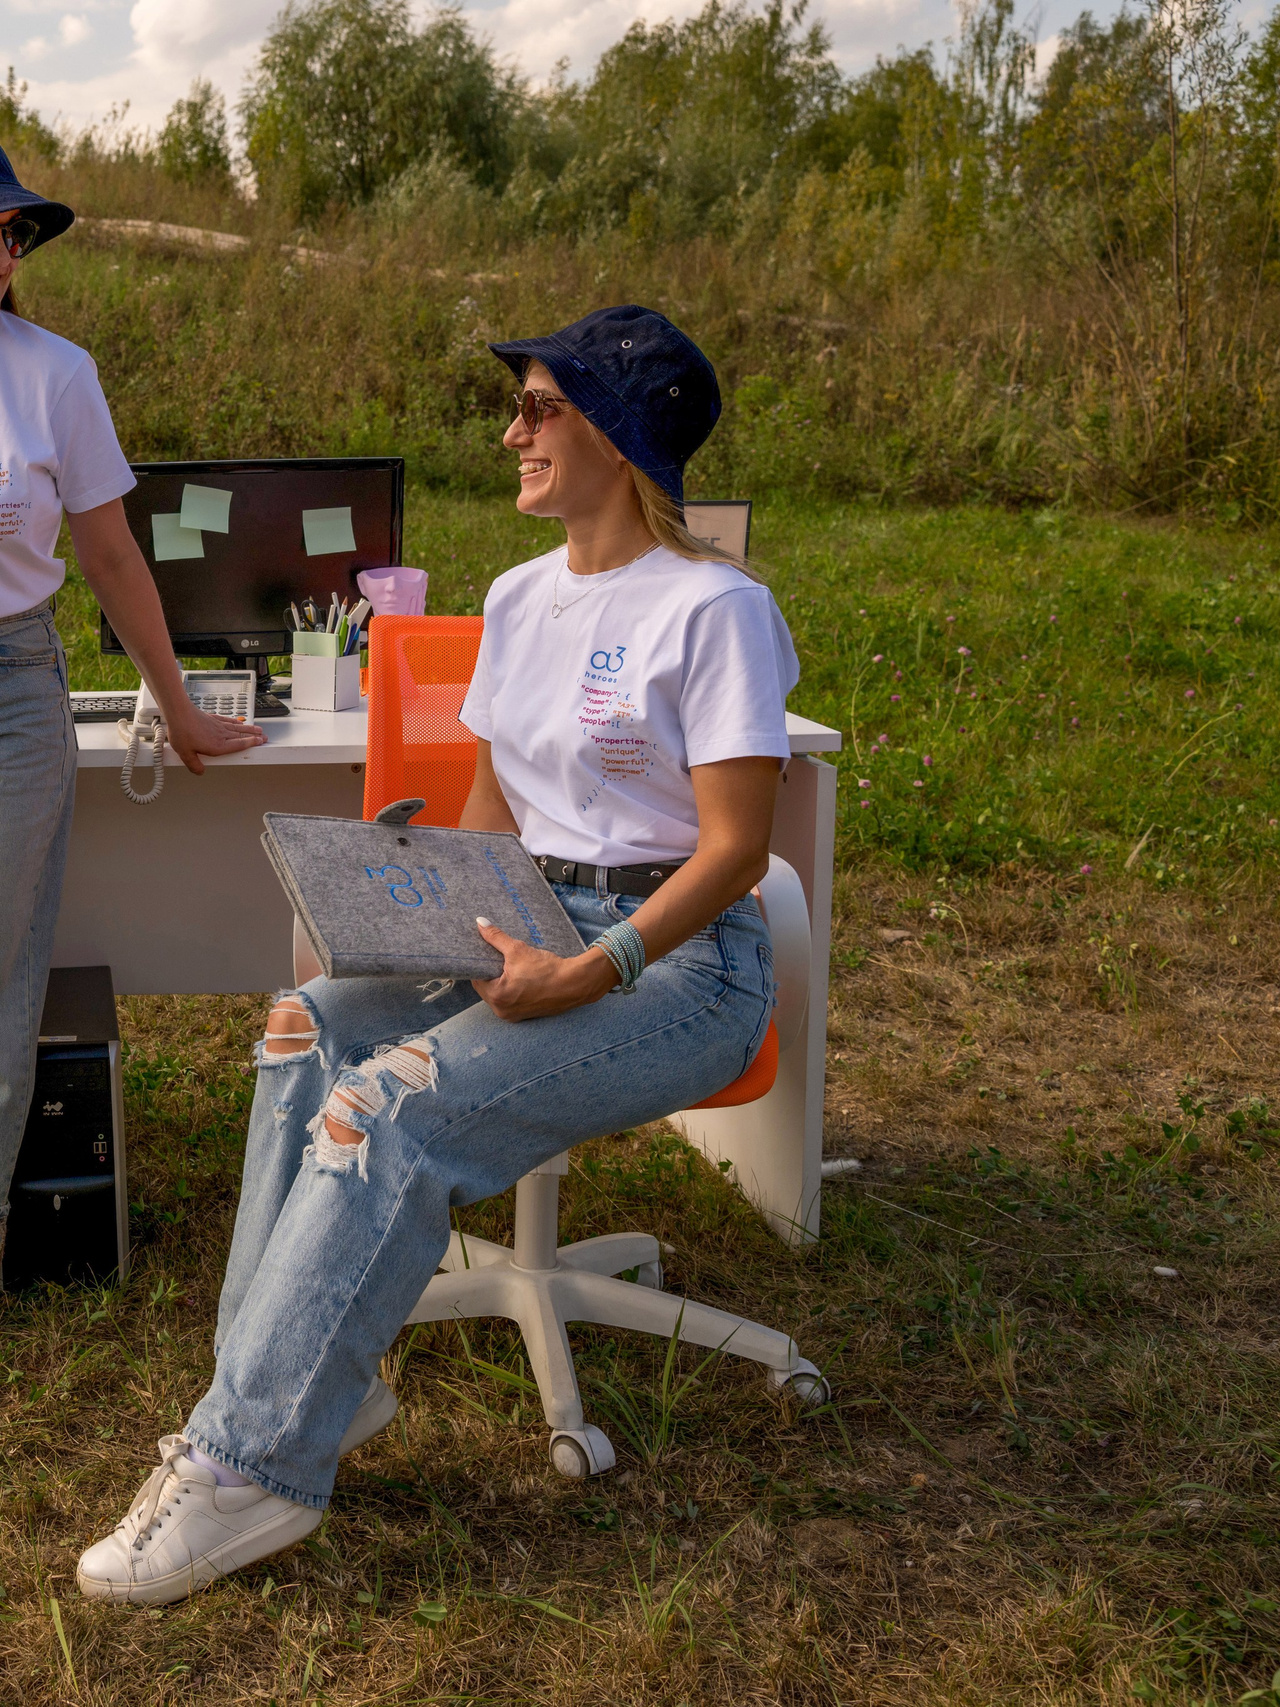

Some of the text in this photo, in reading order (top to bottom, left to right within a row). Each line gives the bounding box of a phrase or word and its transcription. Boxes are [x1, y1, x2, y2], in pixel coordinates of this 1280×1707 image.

[590, 646, 626, 673] a3
[584, 671, 617, 683] heroes
[365, 865, 423, 908] a3
